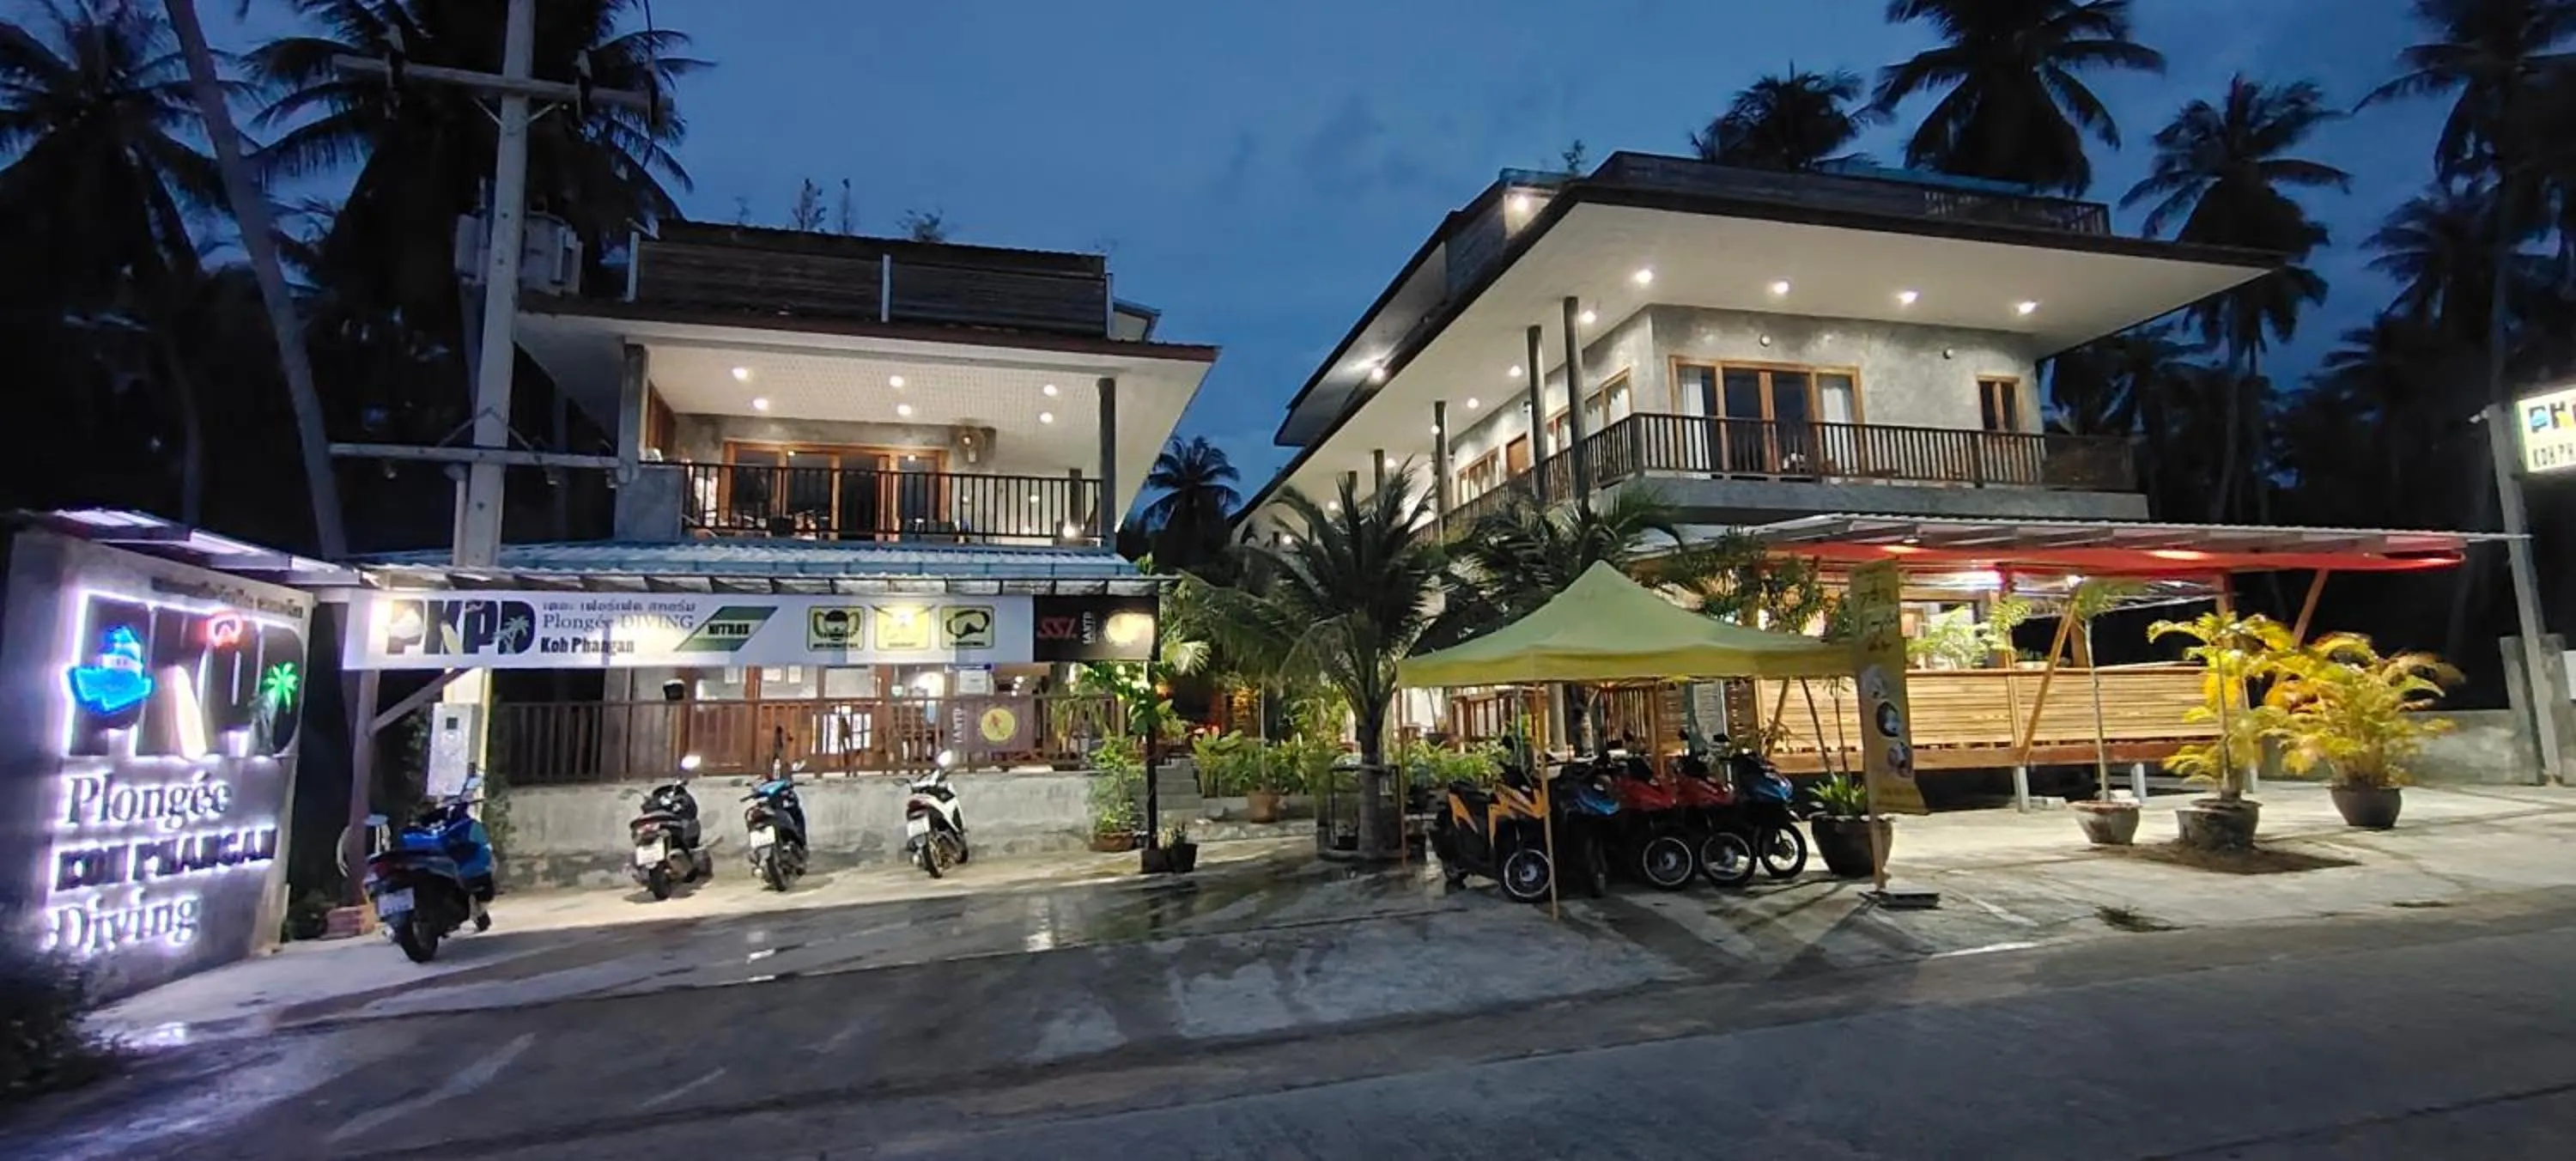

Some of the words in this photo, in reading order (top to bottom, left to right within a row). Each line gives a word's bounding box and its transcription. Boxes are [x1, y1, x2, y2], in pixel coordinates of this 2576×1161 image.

[386, 599, 537, 656] PKPD
[540, 636, 569, 653] Koh
[571, 636, 635, 655] Phangan
[542, 613, 615, 632] Plongée
[620, 613, 695, 629] DIVING
[64, 771, 233, 830] Plongée
[55, 843, 129, 891] KOH
[131, 828, 278, 881] PHANGAN
[43, 890, 203, 952] Diving
